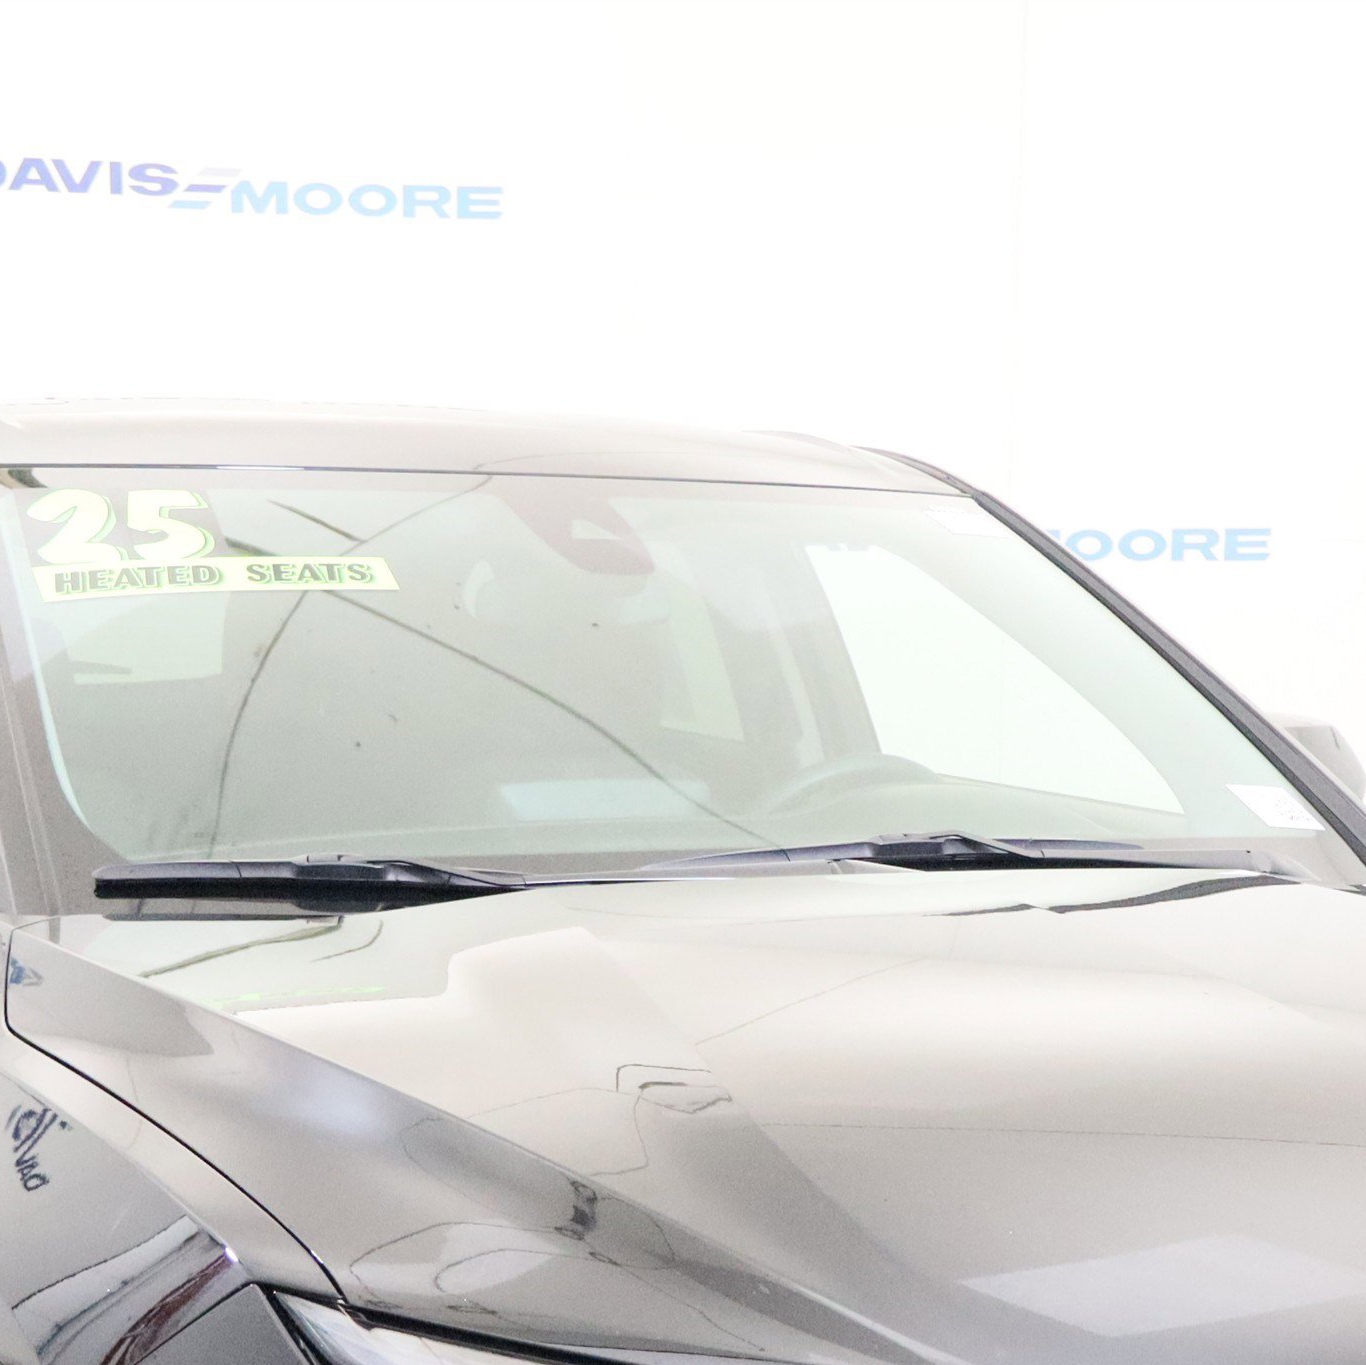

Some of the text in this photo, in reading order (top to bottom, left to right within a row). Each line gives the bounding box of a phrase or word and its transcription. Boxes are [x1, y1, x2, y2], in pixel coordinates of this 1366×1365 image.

[230, 180, 504, 220] MOORE
[26, 488, 215, 565] 25
[1047, 527, 1272, 563] OORE
[54, 562, 374, 595] HEATED SEATS
